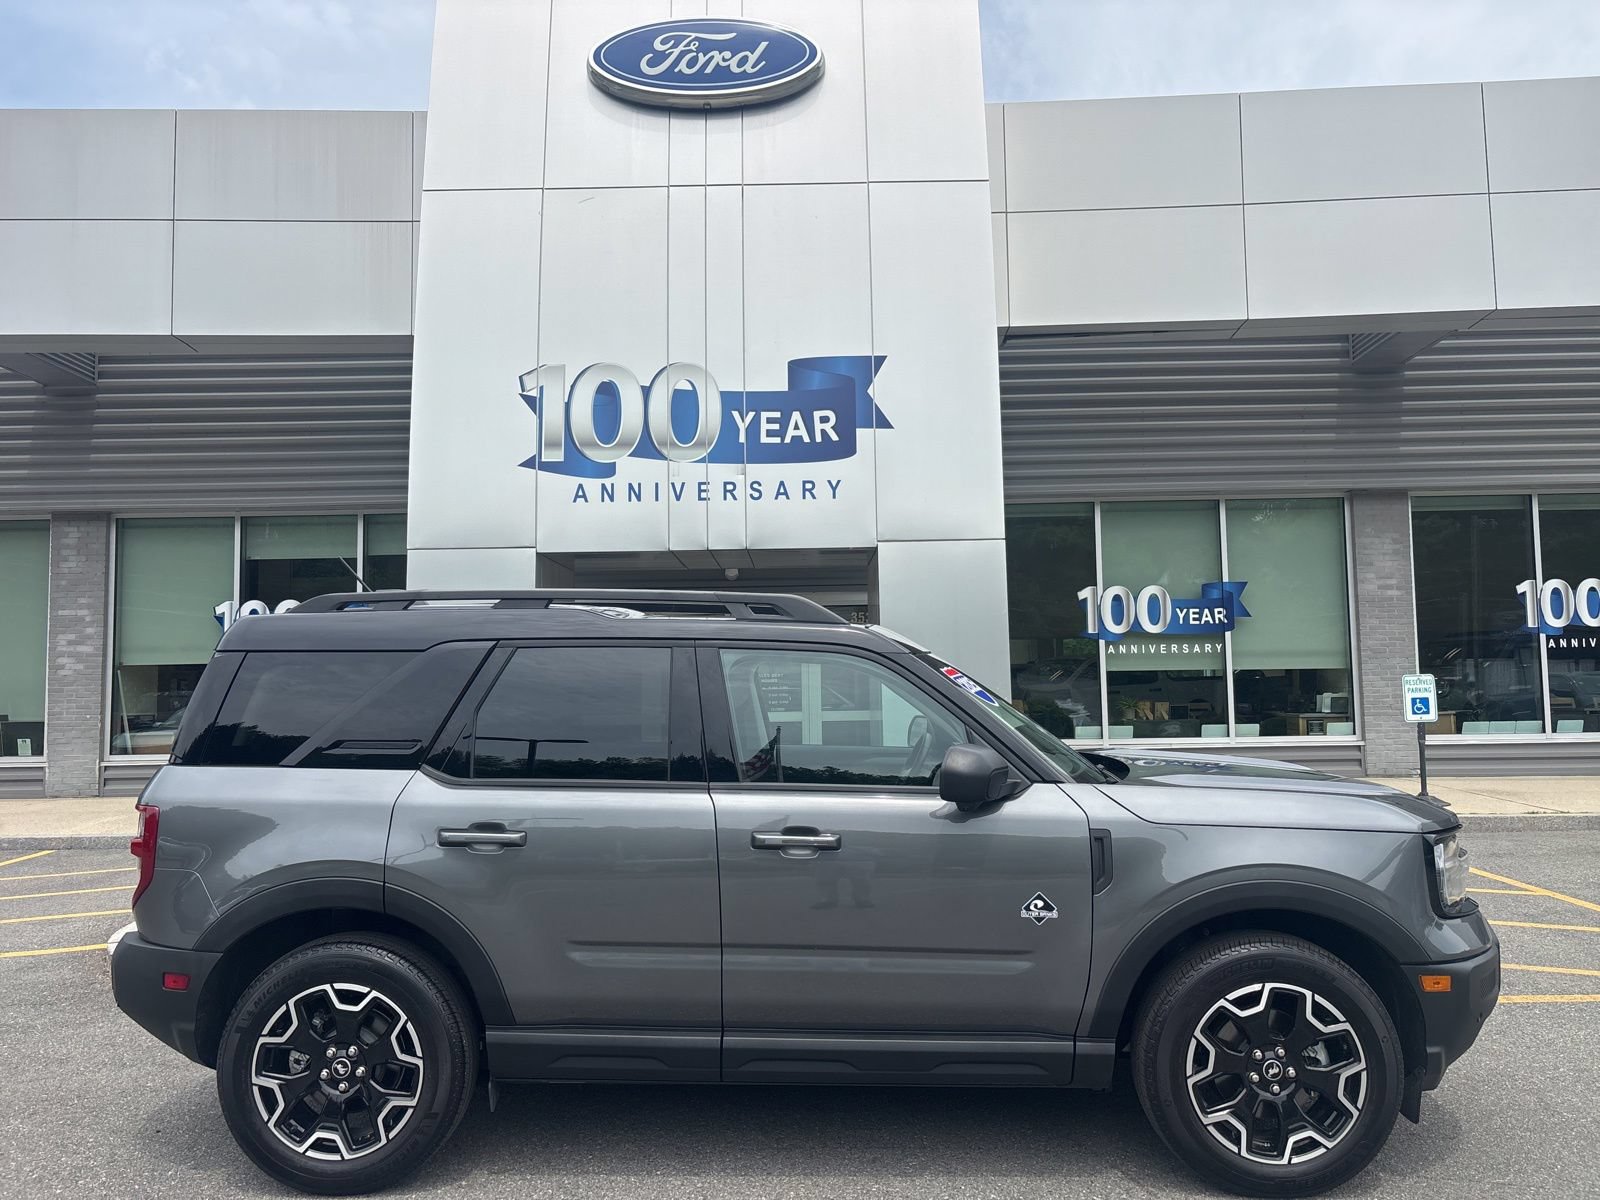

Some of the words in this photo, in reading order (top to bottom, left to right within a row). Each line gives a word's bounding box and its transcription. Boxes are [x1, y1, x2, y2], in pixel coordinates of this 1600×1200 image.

[640, 32, 769, 75] Ford
[518, 361, 722, 464] 100
[731, 409, 840, 444] YEAR
[572, 479, 842, 504] ANNIVERSARY
[1077, 585, 1172, 634] 100
[1175, 608, 1228, 625] YEAR
[1107, 643, 1223, 654] ANNIVERSARY
[1548, 637, 1597, 648] ANNIV
